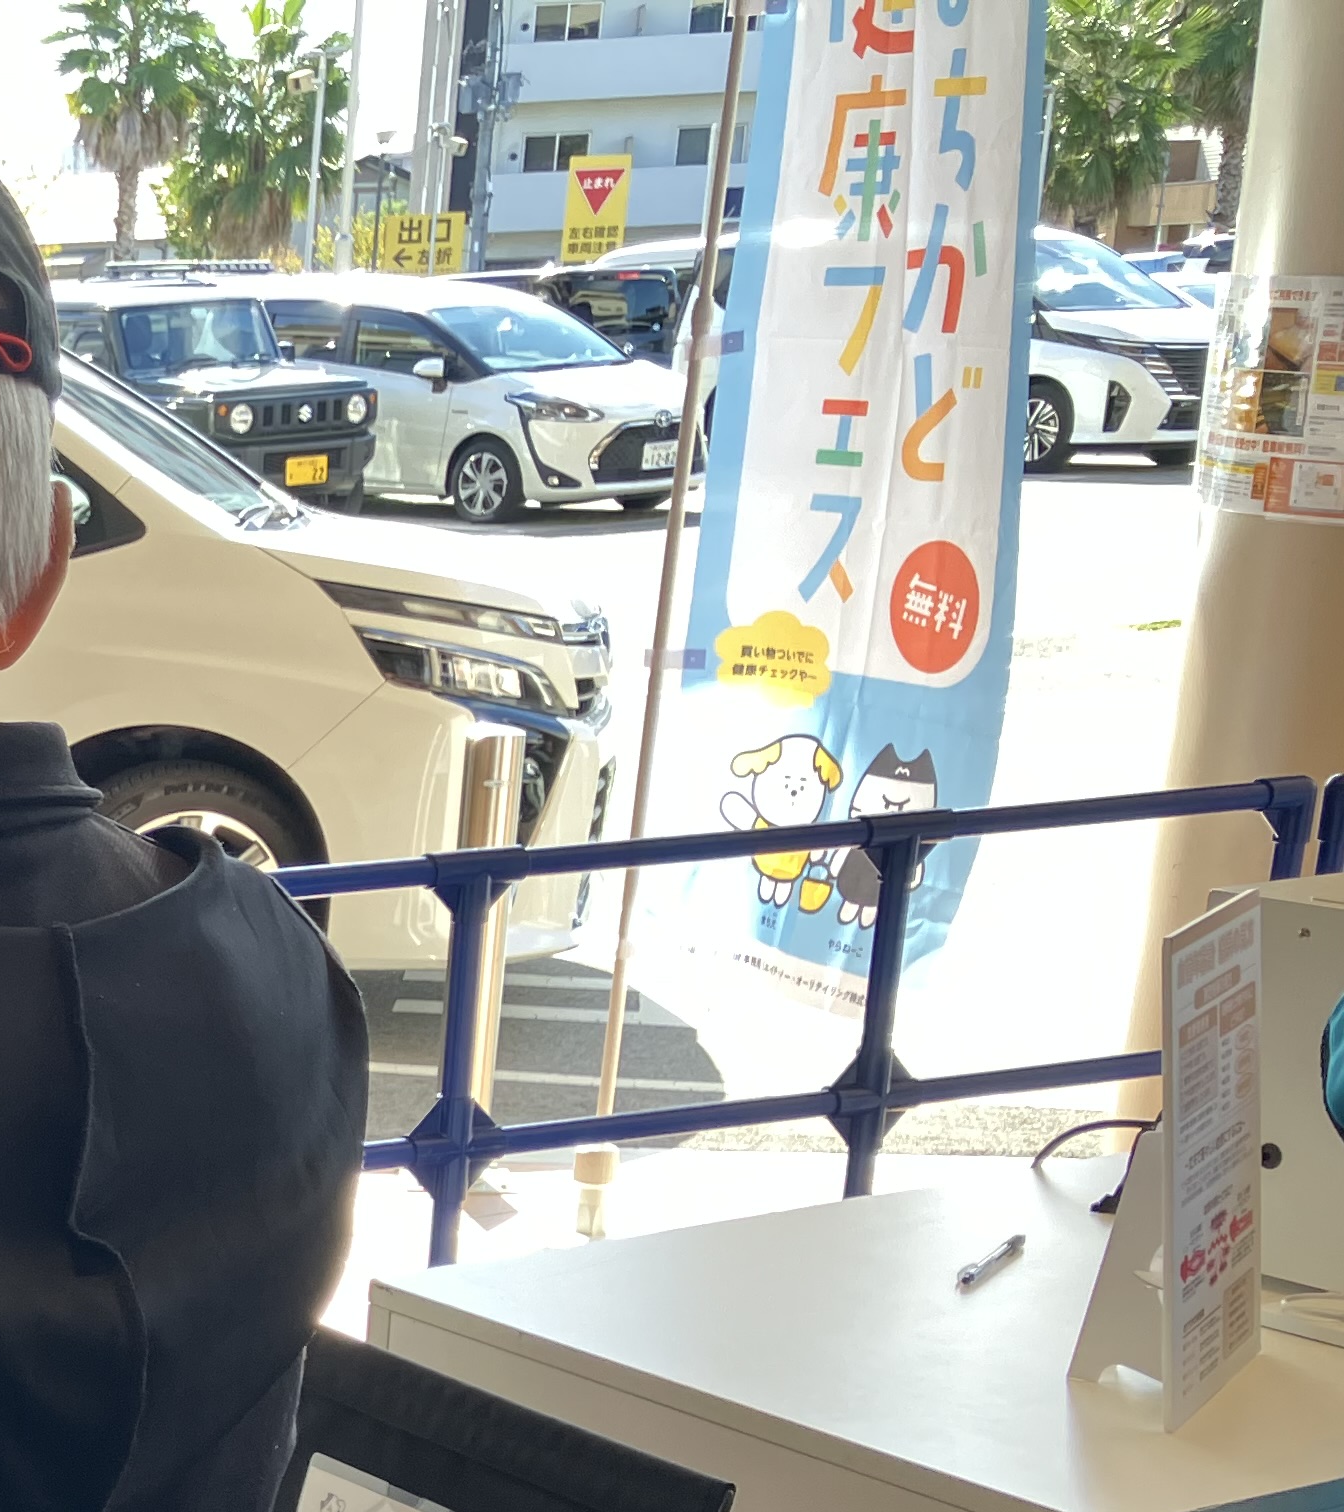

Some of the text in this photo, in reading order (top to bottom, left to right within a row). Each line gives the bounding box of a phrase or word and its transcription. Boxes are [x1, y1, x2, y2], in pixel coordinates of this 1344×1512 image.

[583, 176, 616, 190] 止まれ
[398, 217, 451, 244] 出口
[902, 0, 989, 482] ちかど
[904, 572, 969, 640] 無料
[741, 645, 815, 664] 買い物ついでに
